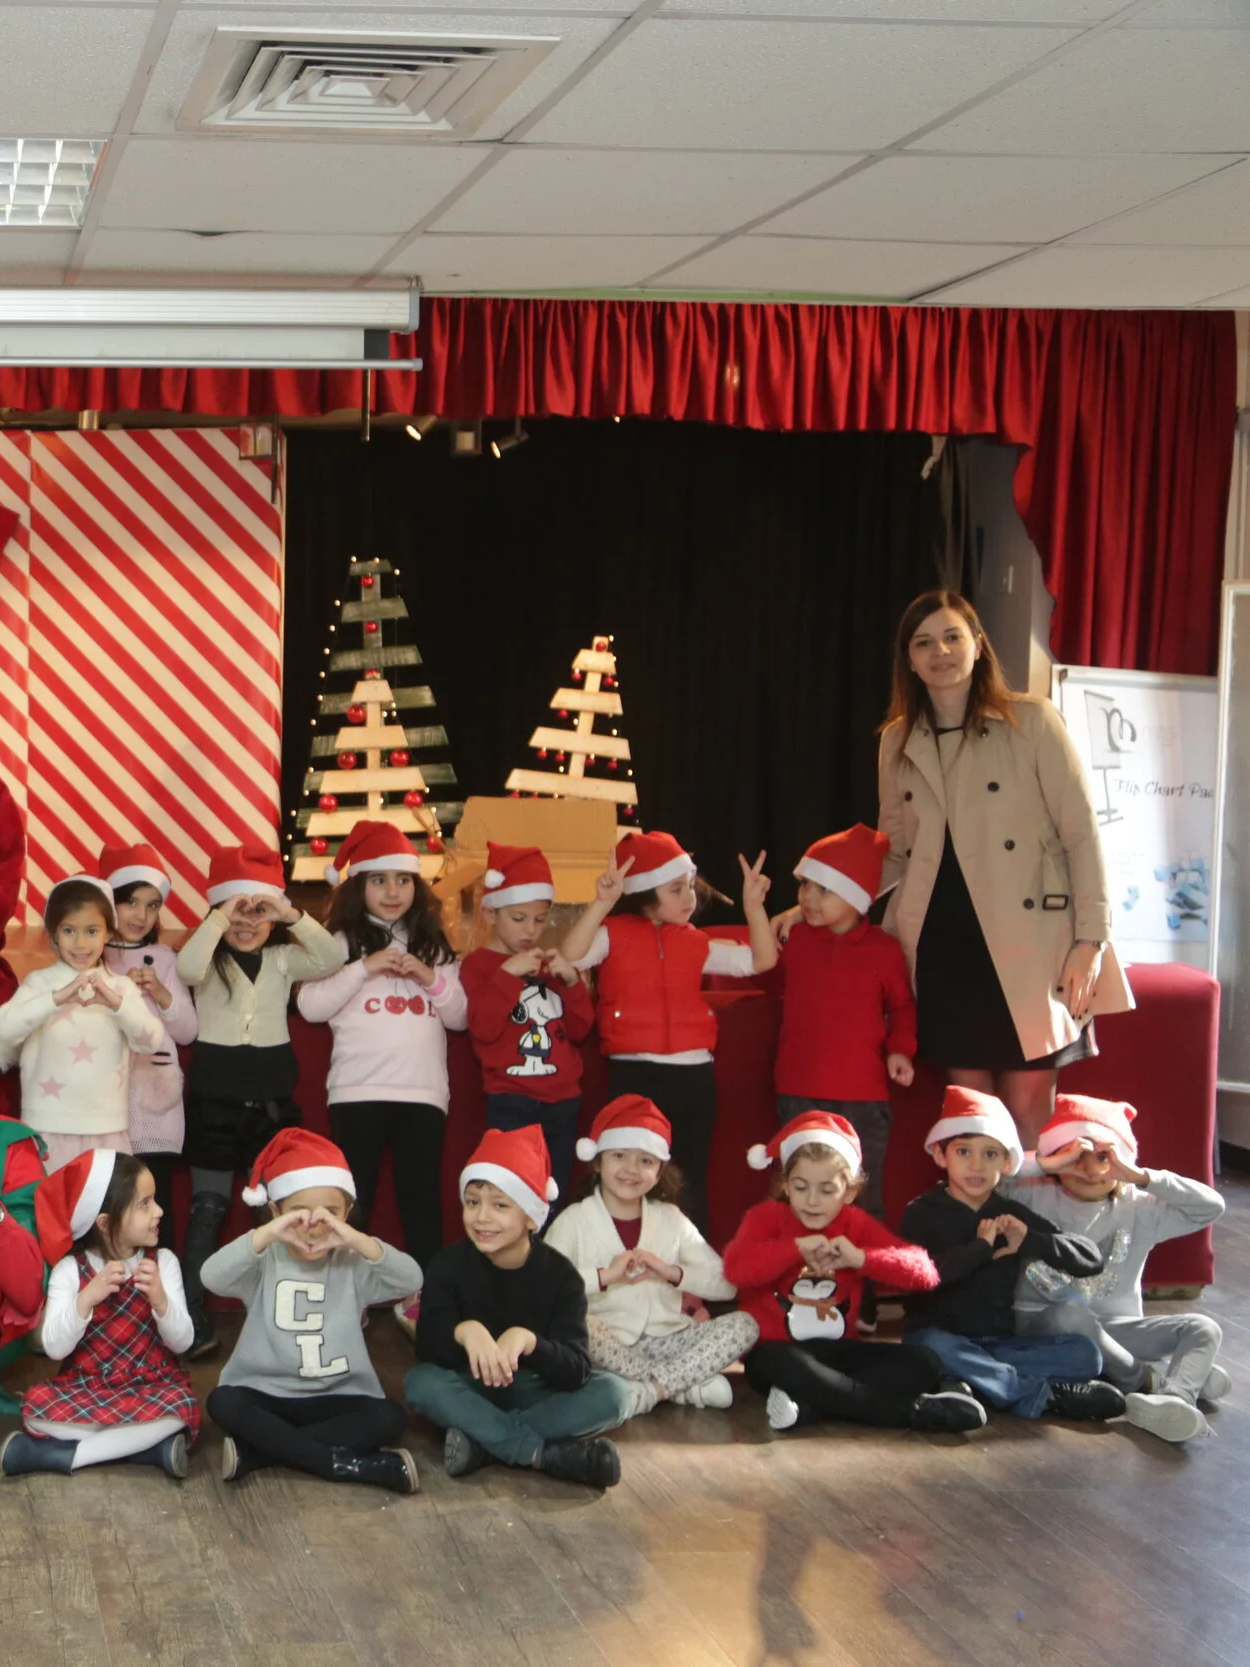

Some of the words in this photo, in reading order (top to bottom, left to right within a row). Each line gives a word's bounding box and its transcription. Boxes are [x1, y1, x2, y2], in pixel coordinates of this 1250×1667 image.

[1145, 781, 1185, 797] Chart
[275, 1279, 325, 1331] C
[296, 1333, 349, 1377] L
